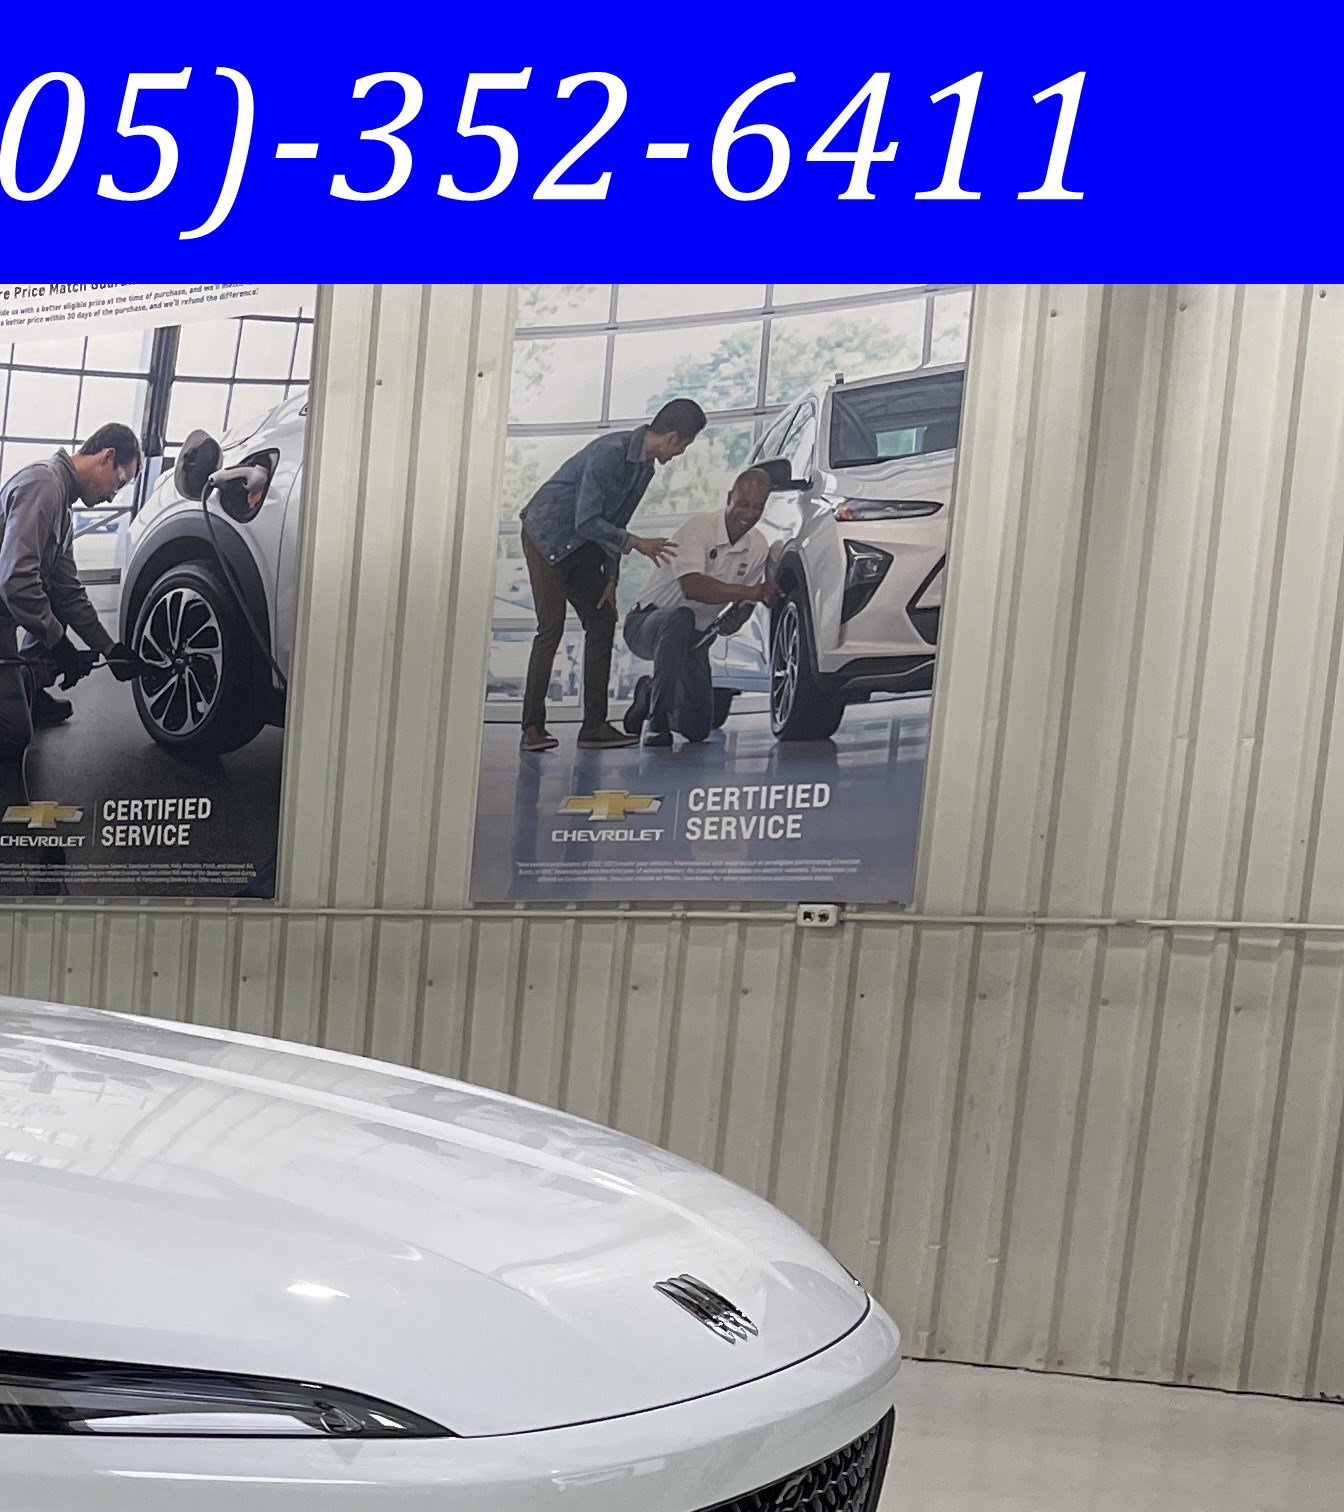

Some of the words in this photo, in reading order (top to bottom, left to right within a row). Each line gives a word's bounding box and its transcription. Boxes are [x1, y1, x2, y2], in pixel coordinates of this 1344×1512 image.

[14, 285, 45, 299] Price
[49, 284, 87, 295] Match
[89, 300, 105, 308] price
[27, 316, 43, 325] price
[77, 311, 91, 319] days
[688, 782, 831, 812] CERTIFIED
[103, 798, 212, 821] CERTIFIED
[685, 814, 803, 840] SERVICE
[0, 835, 86, 847] CHEVROLET
[101, 824, 190, 847] SERVICE
[551, 828, 665, 842] CHEVROLET
